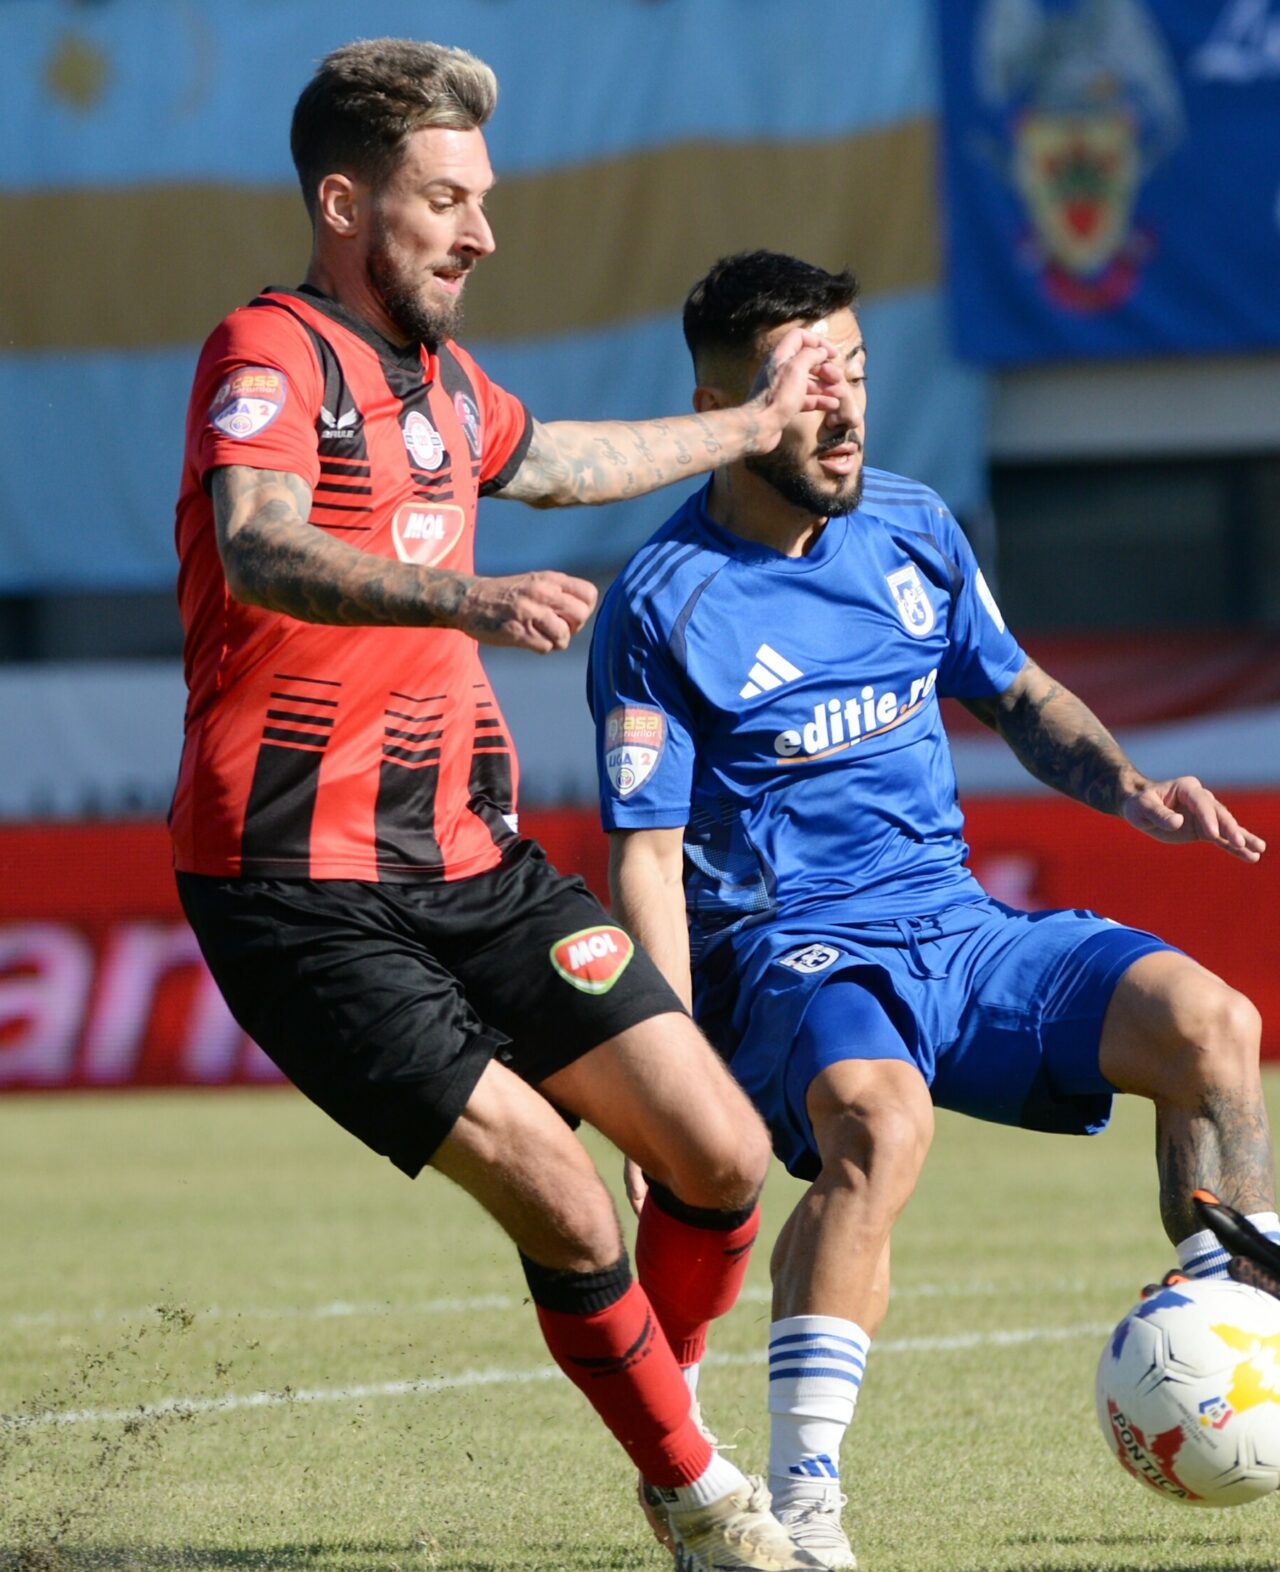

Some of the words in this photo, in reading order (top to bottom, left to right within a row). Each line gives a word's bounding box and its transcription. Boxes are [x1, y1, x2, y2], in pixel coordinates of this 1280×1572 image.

[259, 404, 270, 417] 2
[403, 512, 446, 539] MOL
[640, 752, 651, 766] 2
[567, 932, 619, 971] MOL
[1113, 1412, 1188, 1499] PONTICA
